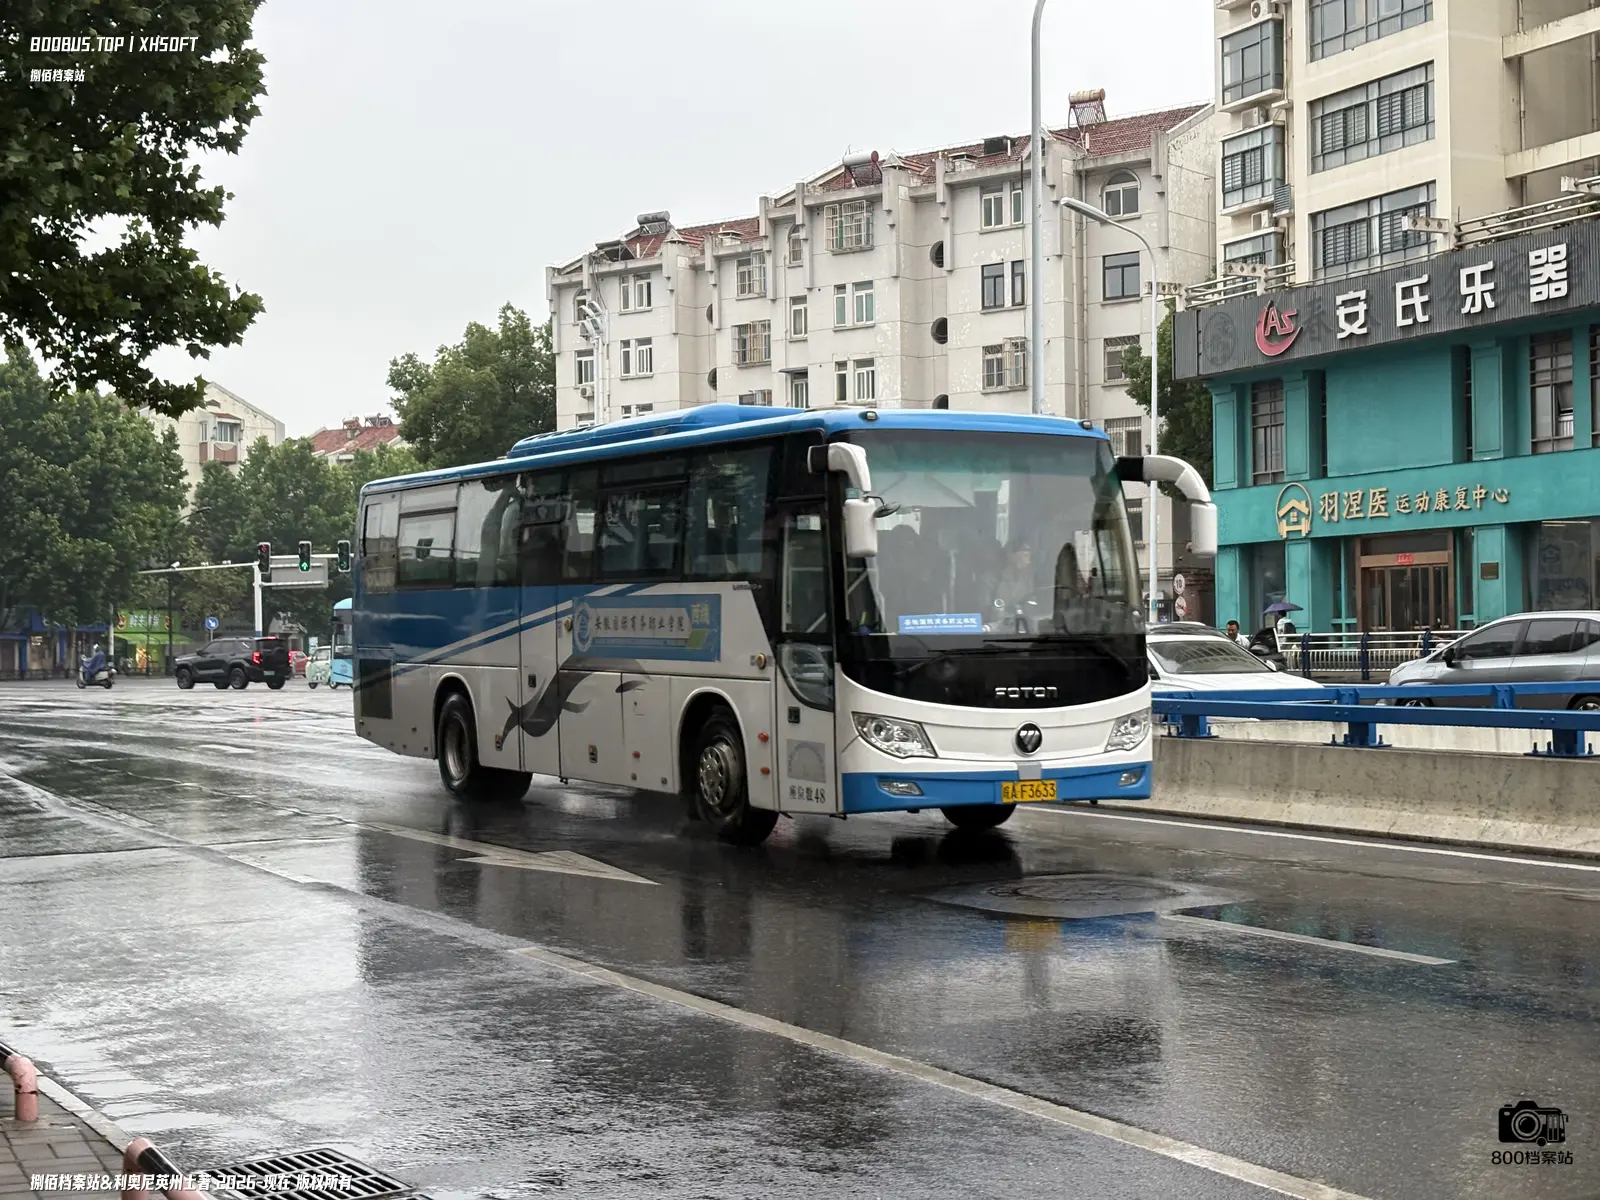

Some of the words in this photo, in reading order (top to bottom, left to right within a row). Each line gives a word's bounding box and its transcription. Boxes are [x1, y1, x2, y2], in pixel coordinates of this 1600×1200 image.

[1335, 242, 1568, 340] 安氏乐器
[1394, 484, 1510, 513] 运动康复中心
[995, 687, 1057, 698] FOTON
